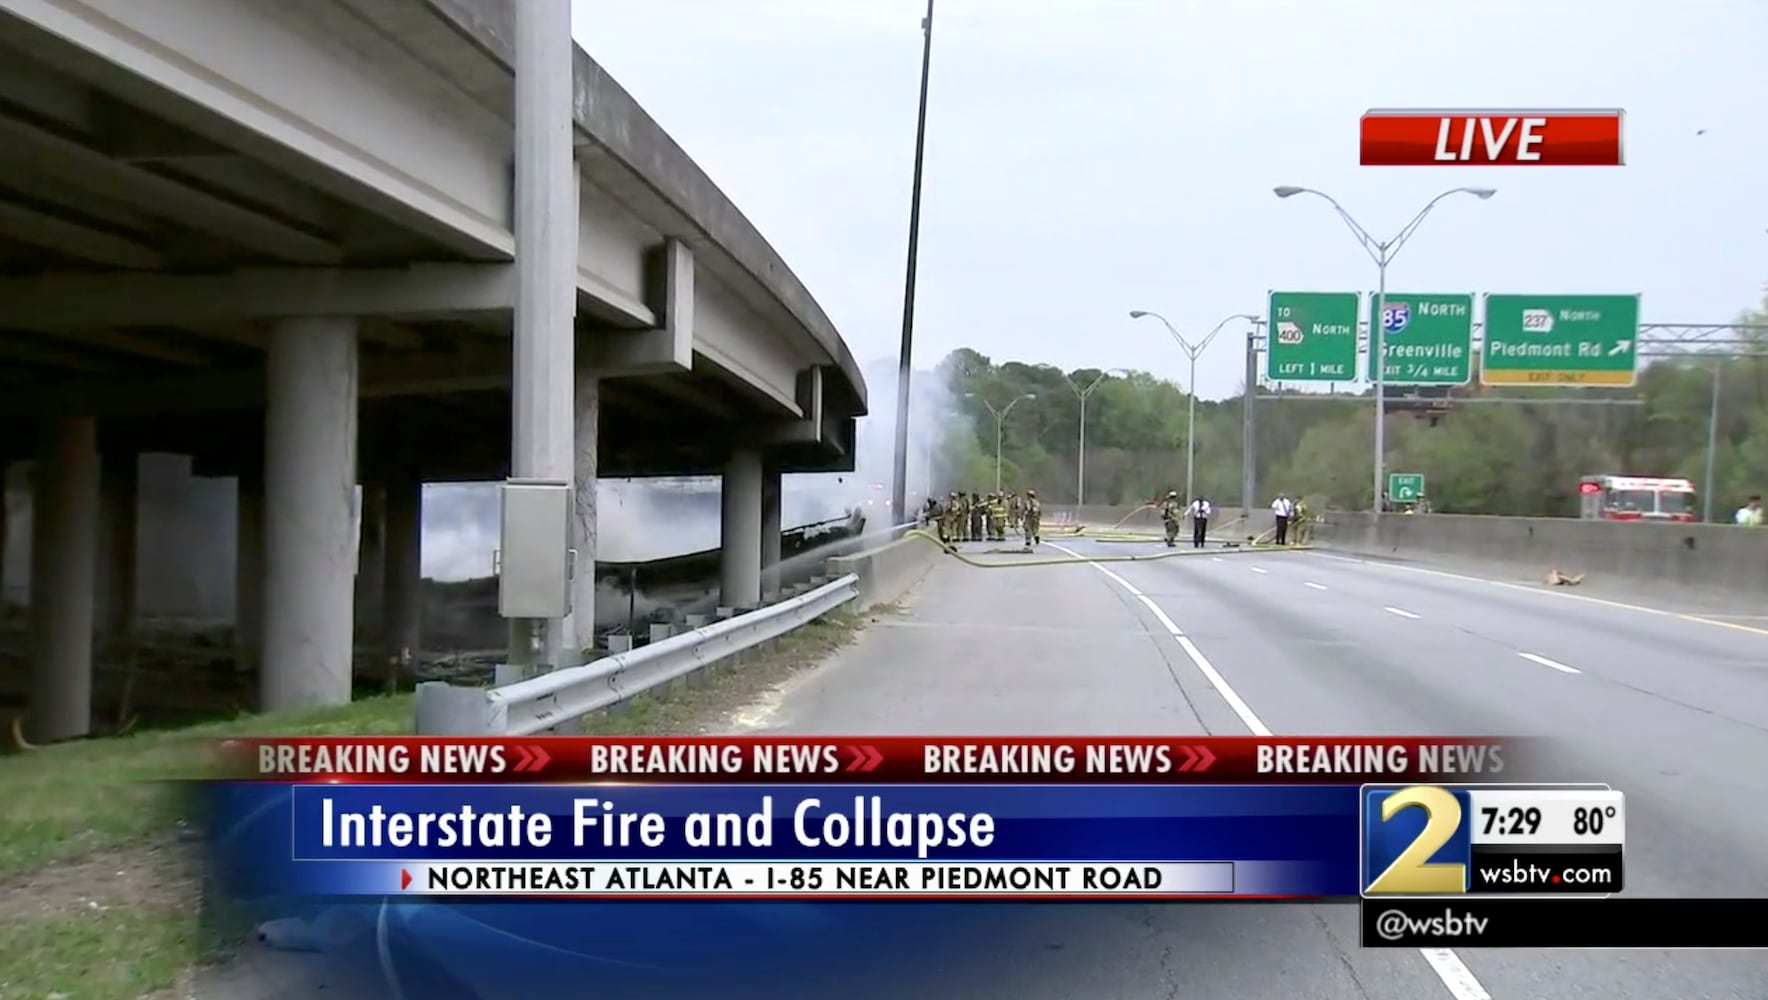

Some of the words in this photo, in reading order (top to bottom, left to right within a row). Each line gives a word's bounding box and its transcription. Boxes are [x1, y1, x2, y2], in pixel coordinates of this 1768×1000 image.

[1278, 307, 1291, 317] TO
[1419, 301, 1466, 316] NORTH
[1559, 309, 1601, 321] NORTH
[1383, 310, 1407, 328] 85
[1524, 314, 1548, 329] 237
[1280, 329, 1301, 342] 400
[1312, 323, 1351, 336] NORTH
[1490, 340, 1572, 358] Piedmont
[1578, 341, 1602, 358] Rd
[1279, 363, 1304, 375] LEFT
[1310, 362, 1316, 377] 1
[1320, 364, 1345, 375] MILE
[1383, 365, 1400, 376] XIT
[1407, 364, 1429, 377] 3/4
[1433, 366, 1459, 377] MILE
[1528, 372, 1550, 382] EXIT
